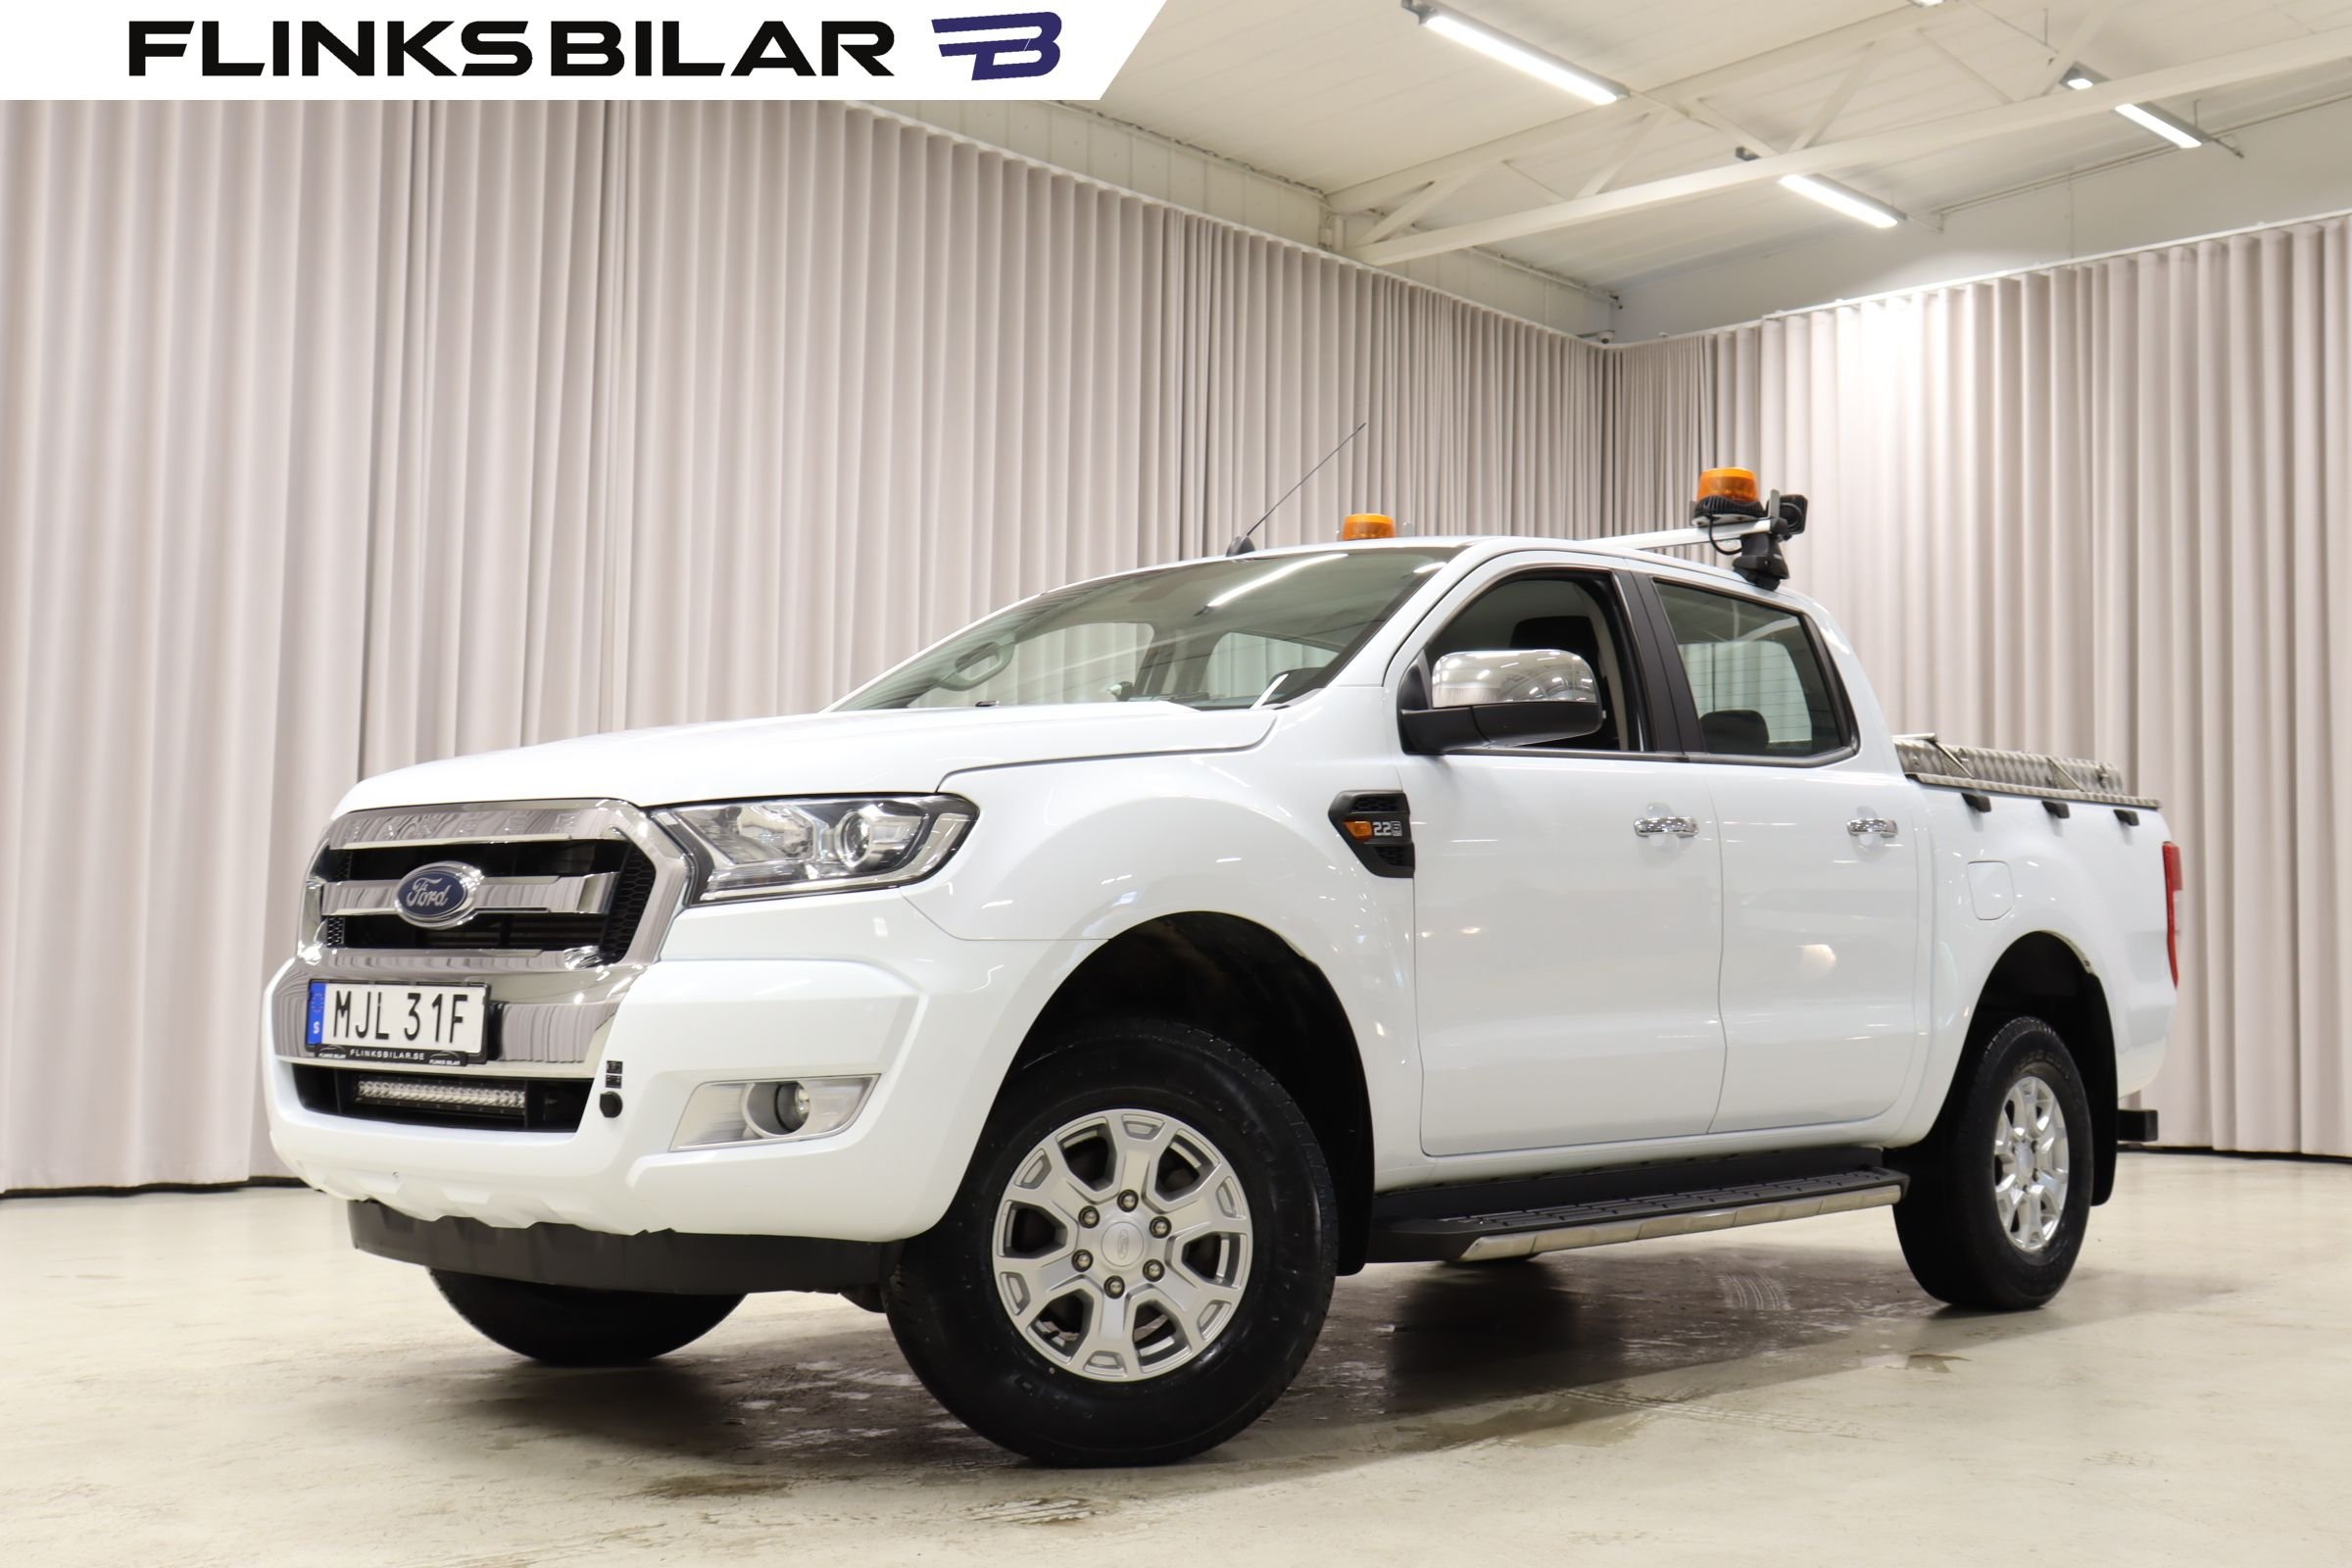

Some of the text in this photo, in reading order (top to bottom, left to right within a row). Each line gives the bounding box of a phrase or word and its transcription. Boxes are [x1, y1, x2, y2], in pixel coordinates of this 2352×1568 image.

[406, 877, 452, 907] Ford
[313, 1021, 320, 1035] S
[333, 990, 468, 1044] MJL 31F
[350, 1049, 424, 1060] FLINKSBILAR.SE
